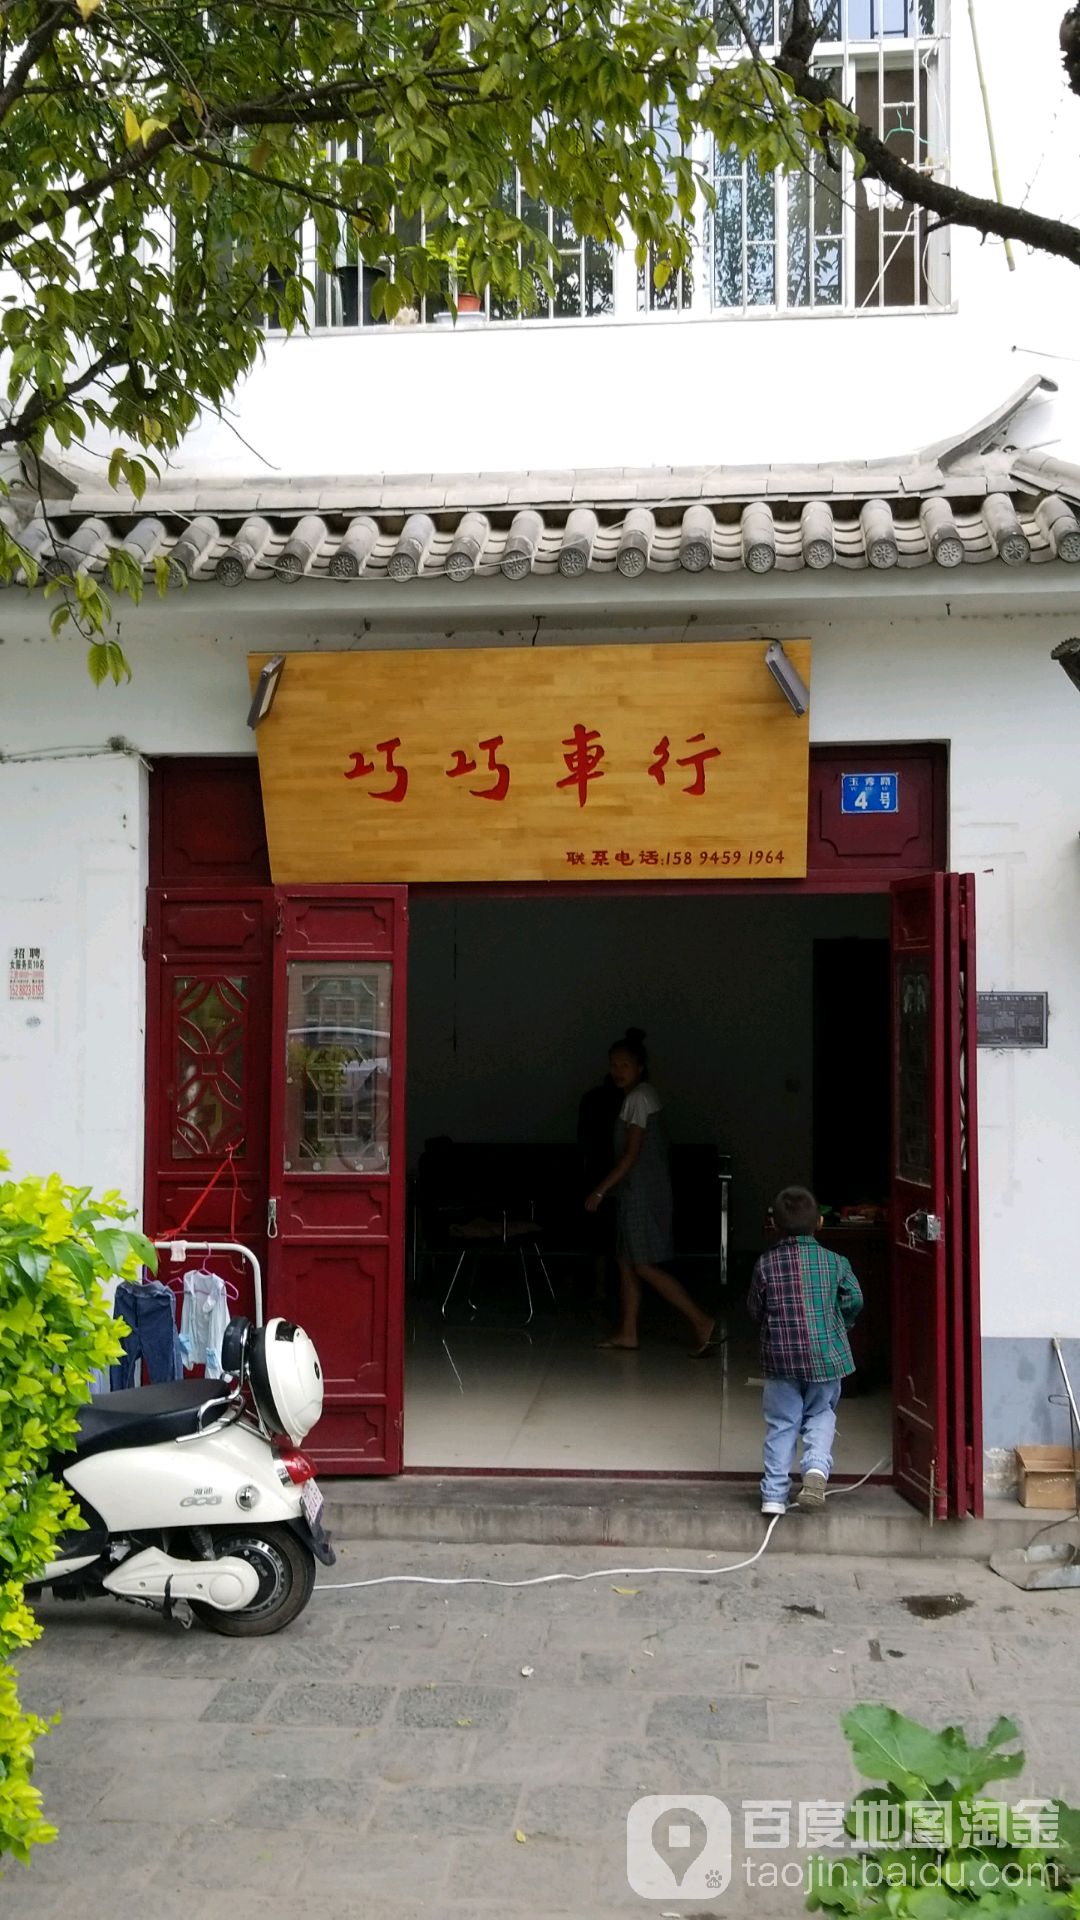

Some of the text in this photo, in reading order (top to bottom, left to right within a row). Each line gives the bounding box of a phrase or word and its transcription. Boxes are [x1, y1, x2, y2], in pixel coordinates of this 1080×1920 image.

[344, 723, 721, 807] 巧巧車行
[855, 791, 890, 809] 4号
[700, 850, 741, 865] 9459
[748, 850, 785, 865] 1964
[14, 948, 41, 959] 招聘
